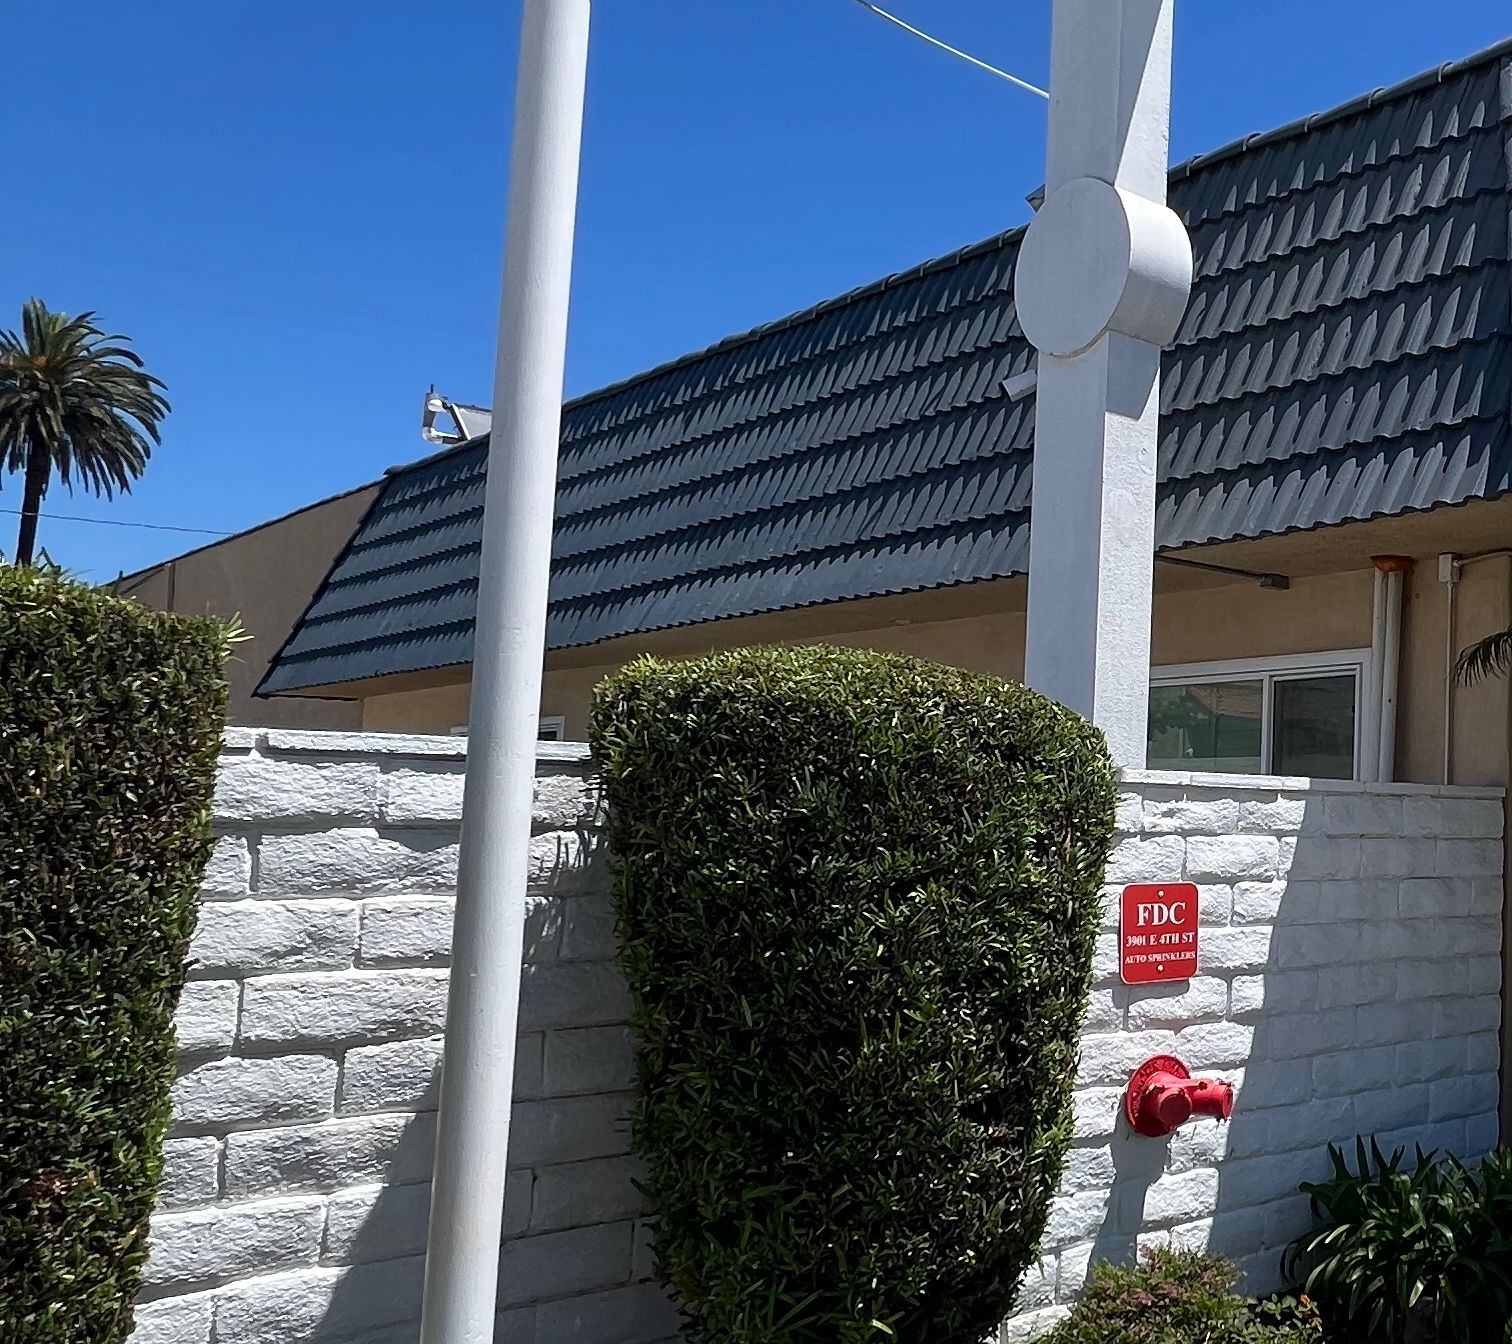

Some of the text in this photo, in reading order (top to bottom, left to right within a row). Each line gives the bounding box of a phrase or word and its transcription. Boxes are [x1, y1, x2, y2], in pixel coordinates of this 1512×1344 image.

[1136, 902, 1186, 927] FDC
[1126, 932, 1195, 947] 3901 E 4TH ST
[1125, 951, 1196, 964] AUTO SPRINKLERS
